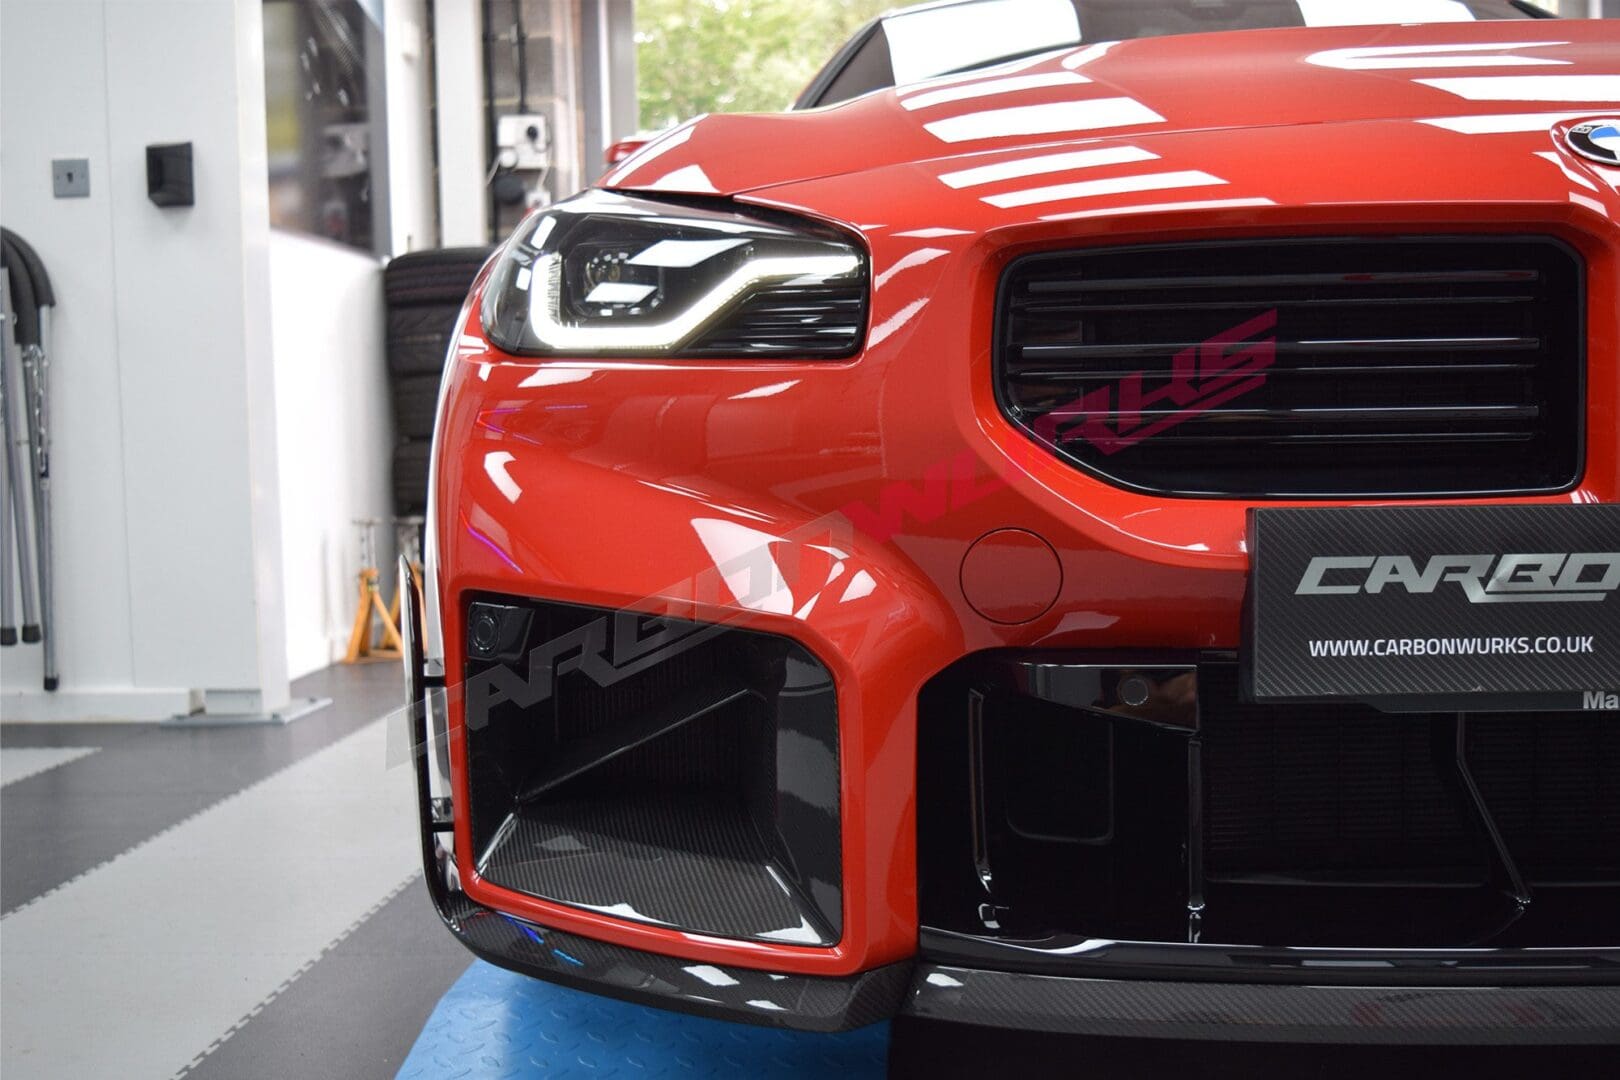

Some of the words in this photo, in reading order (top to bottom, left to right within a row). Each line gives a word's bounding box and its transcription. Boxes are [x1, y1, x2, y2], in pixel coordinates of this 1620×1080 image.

[1295, 553, 1620, 603] CARBO
[1308, 636, 1594, 657] WWW.CARBONWURKS.CO.UK
[1583, 690, 1619, 709] Ma
